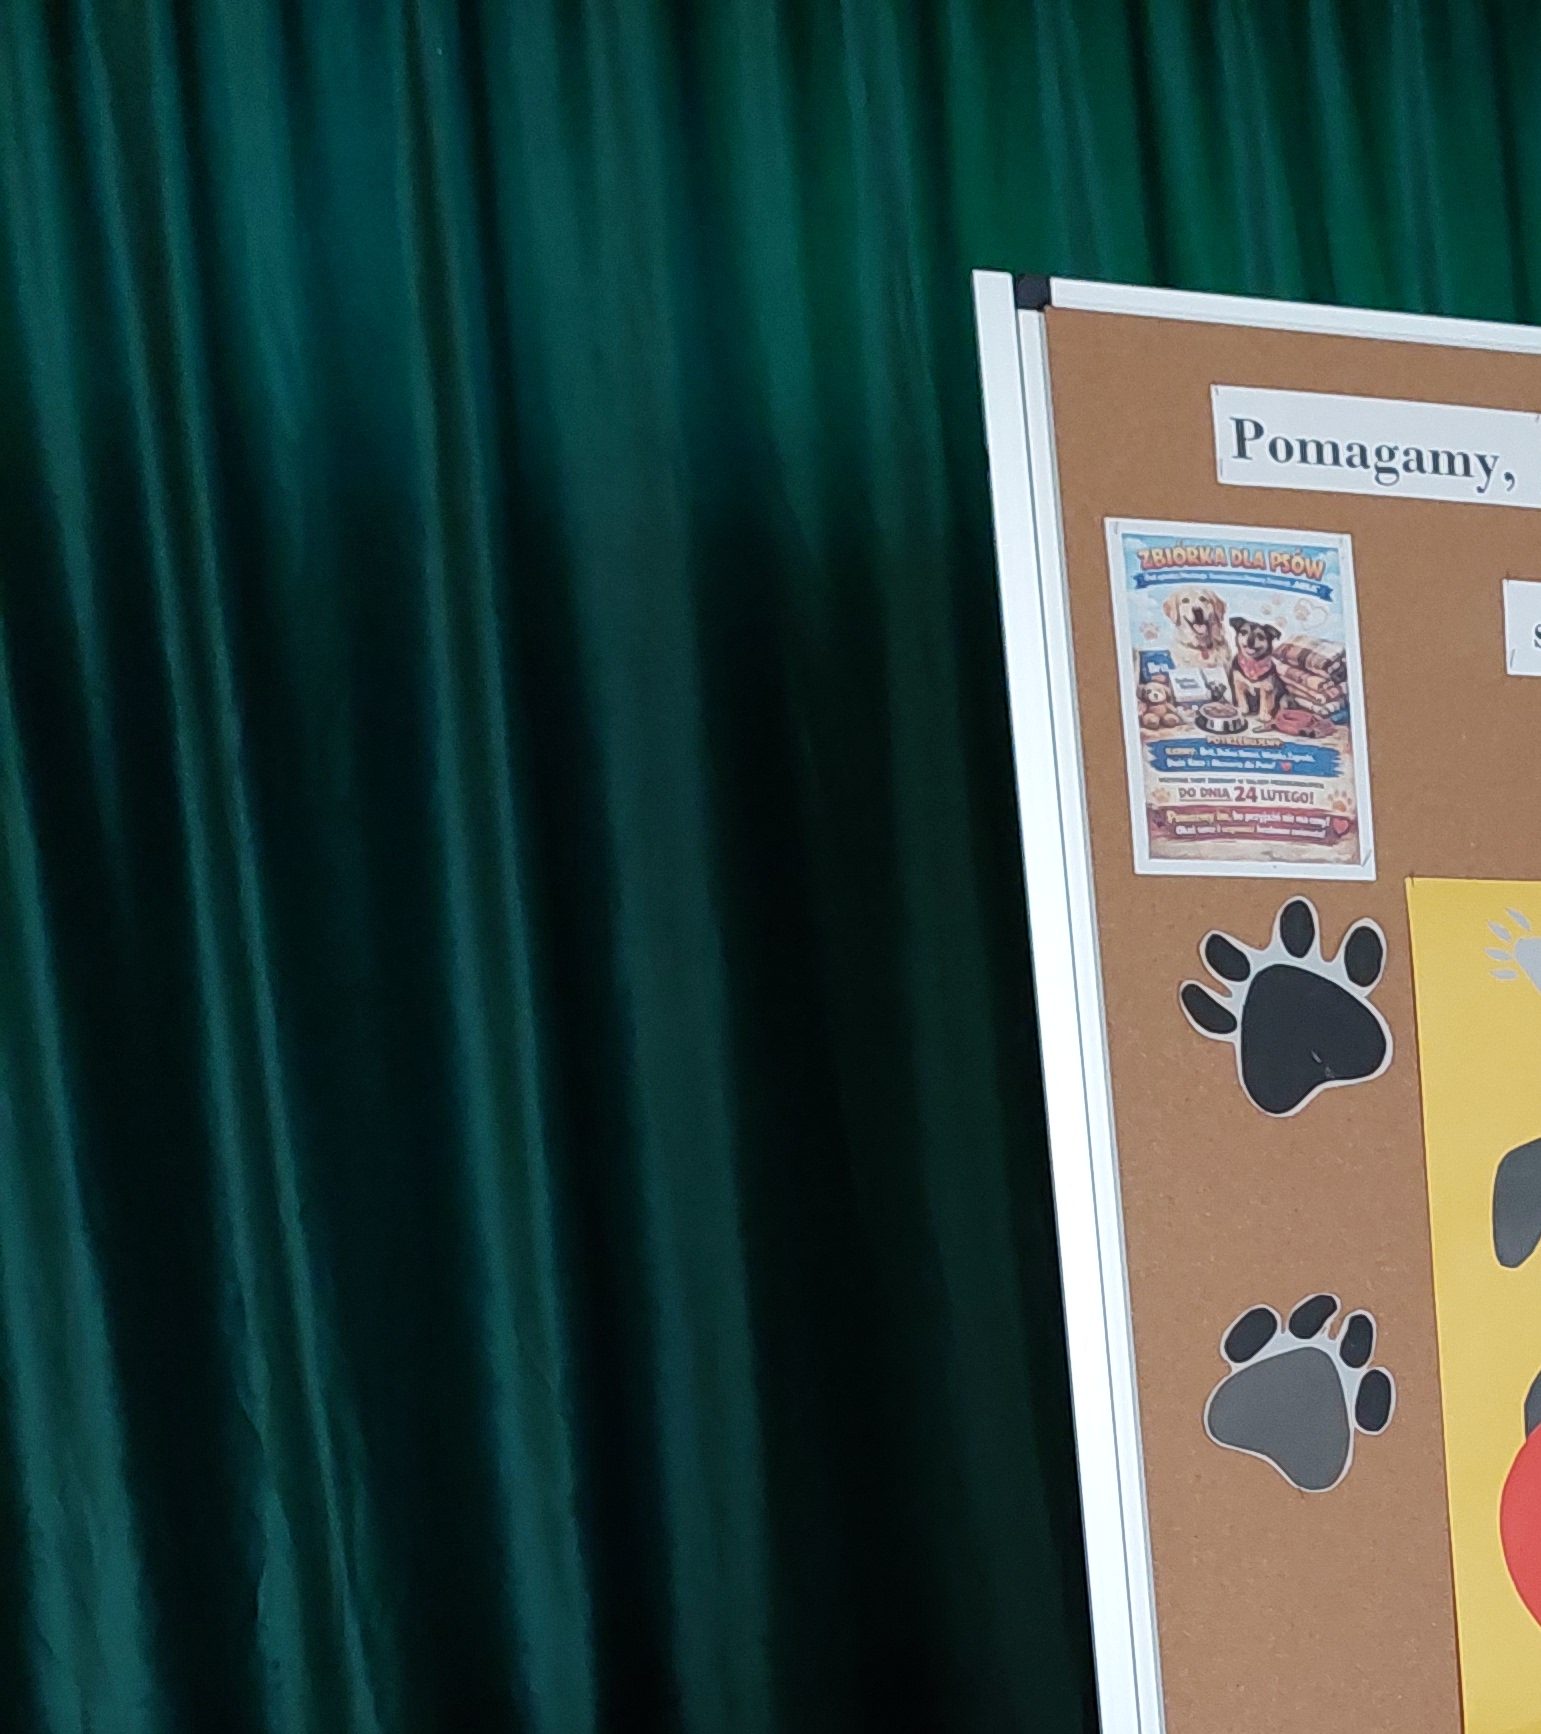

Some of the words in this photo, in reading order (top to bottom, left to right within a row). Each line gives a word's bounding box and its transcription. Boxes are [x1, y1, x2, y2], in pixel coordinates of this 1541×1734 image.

[1229, 415, 1518, 492] Pomagamy,
[1138, 542, 1228, 570] ZBIÓRKA
[1230, 547, 1266, 570] DLA
[1269, 548, 1326, 581] PSÓW
[1179, 787, 1197, 798] DO
[1200, 788, 1230, 799] DNIA
[1234, 786, 1258, 802] 24
[1261, 789, 1315, 805] LUTEGO!
